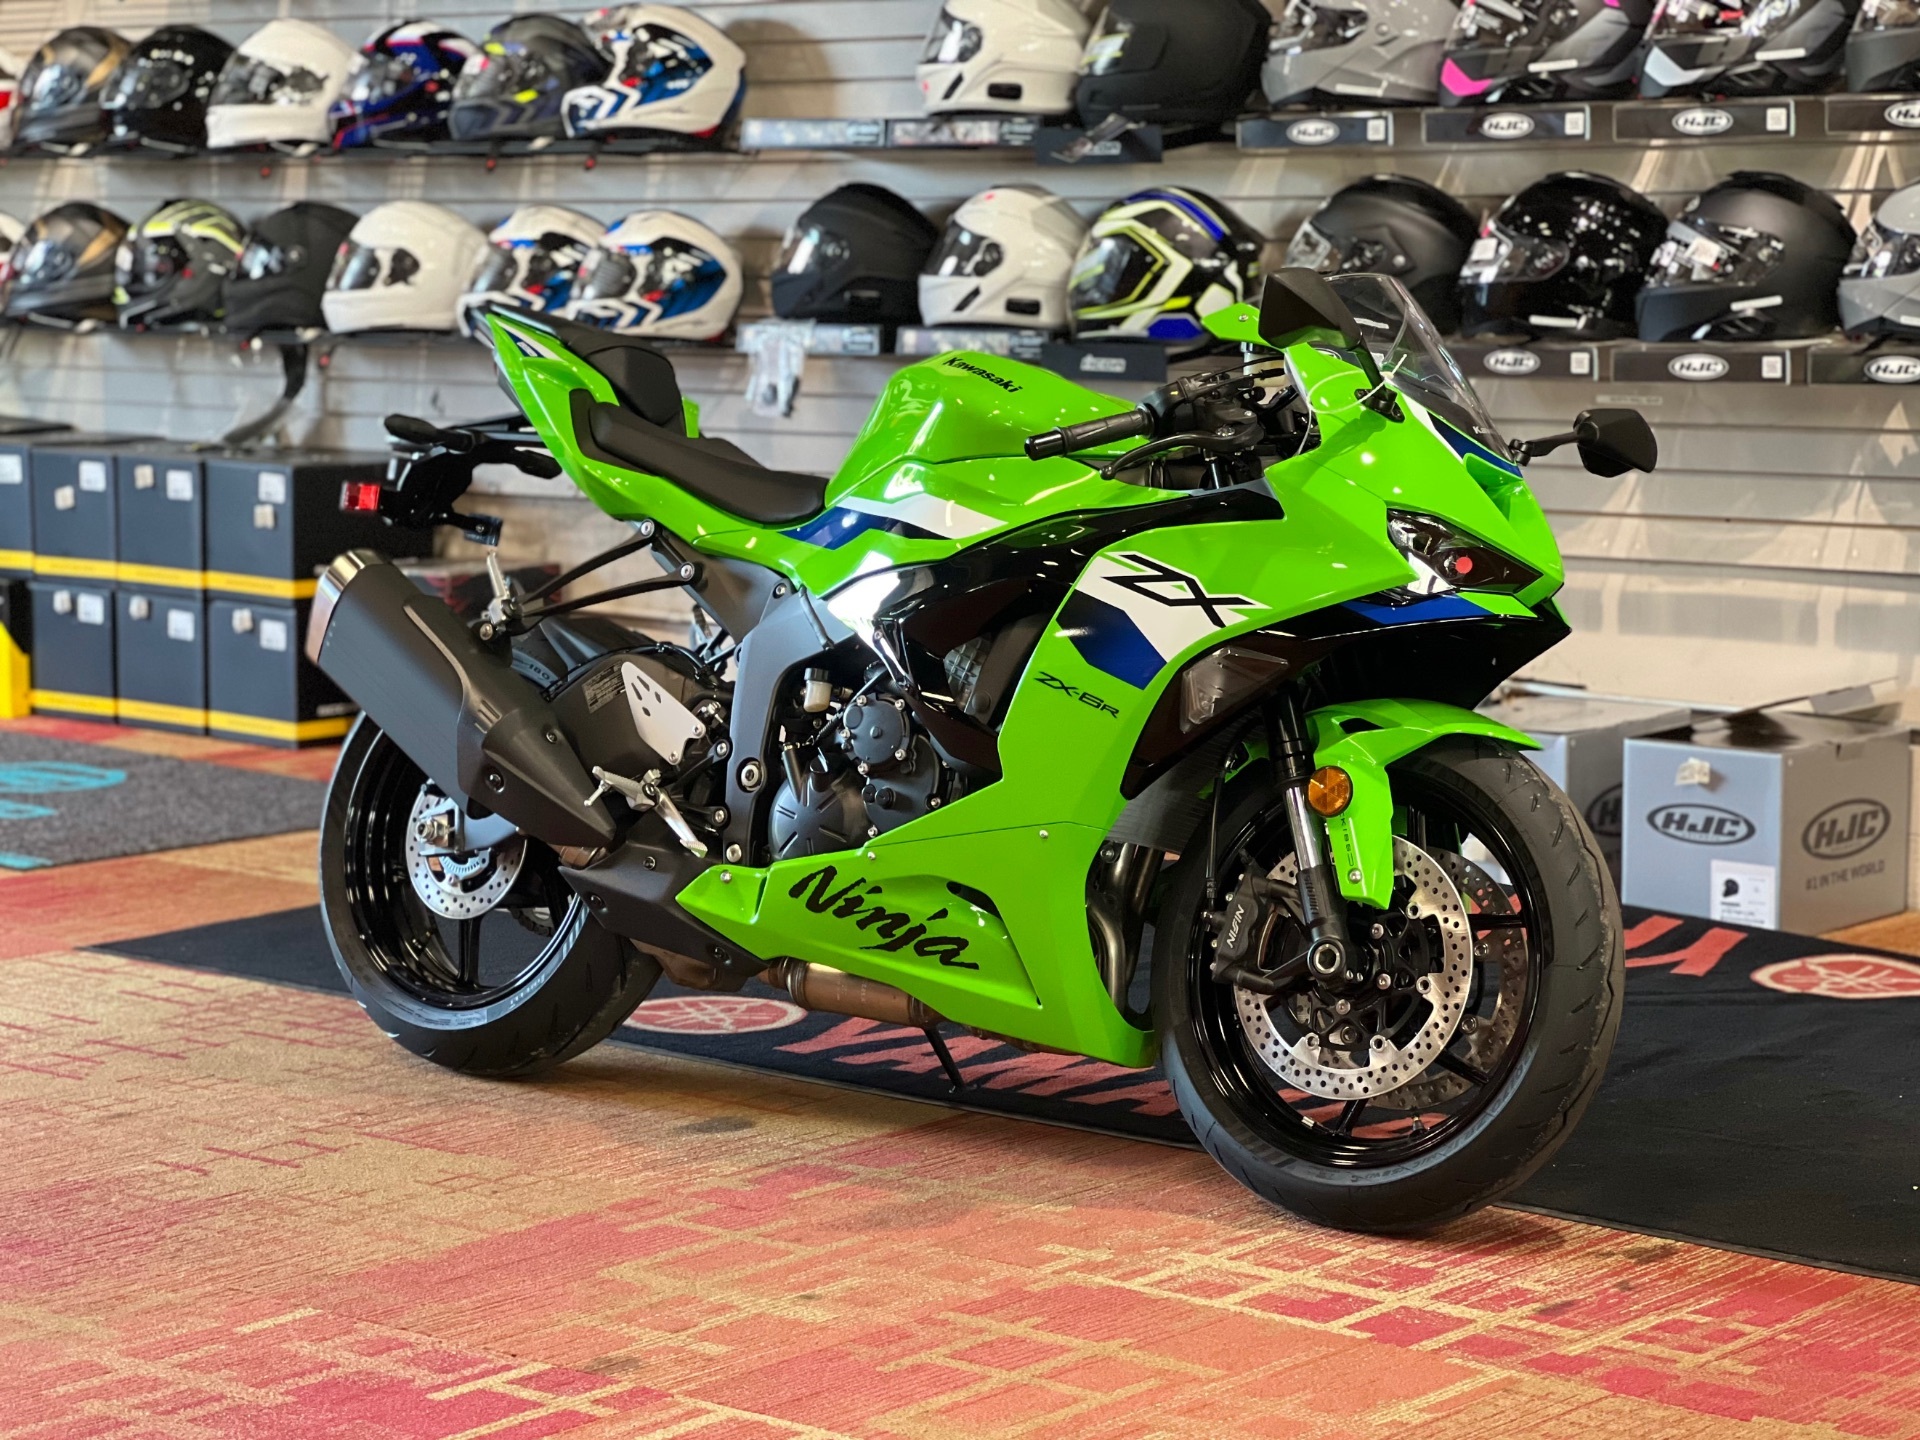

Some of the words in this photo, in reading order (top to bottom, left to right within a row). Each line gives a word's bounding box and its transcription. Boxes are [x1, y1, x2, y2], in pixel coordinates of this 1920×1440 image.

[1296, 125, 1334, 138] HJC
[1486, 119, 1525, 132] HJC
[1682, 115, 1722, 127] HJC
[943, 357, 1023, 393] Kawasaki
[1679, 362, 1720, 373] HJC
[1874, 364, 1917, 374] HJC
[1101, 554, 1257, 628] ZX
[1034, 670, 1120, 719] ZX-6R
[1661, 811, 1741, 837] HJC
[1814, 808, 1881, 850] HJC
[1819, 874, 1830, 888] IN
[1831, 869, 1849, 884] THE
[1851, 859, 1885, 880] WORLD
[788, 864, 980, 970] Ninja
